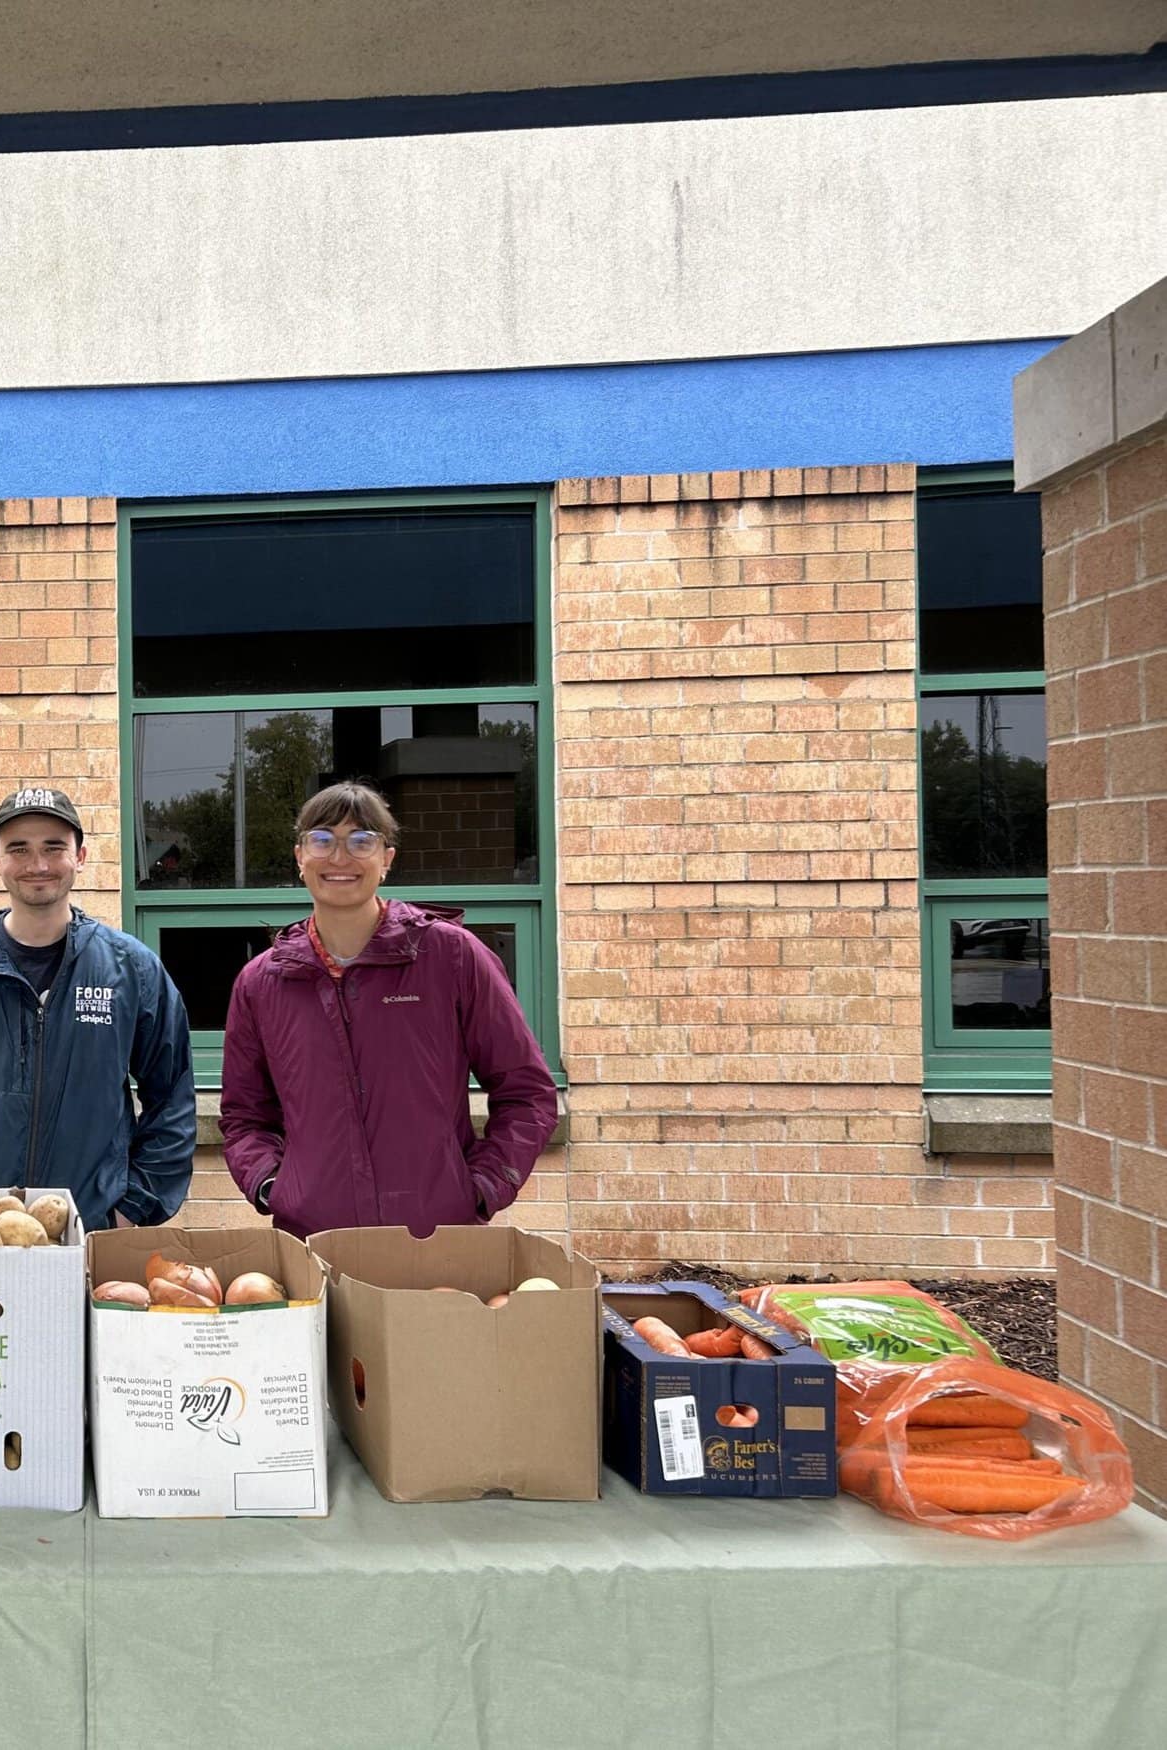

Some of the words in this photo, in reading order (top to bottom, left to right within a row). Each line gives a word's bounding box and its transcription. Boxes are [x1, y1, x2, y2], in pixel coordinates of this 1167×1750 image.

[76, 987, 113, 1000] FOOD
[389, 994, 420, 1003] Columbia
[76, 1005, 111, 1013] NETWORK
[80, 1014, 104, 1024] Shipt
[128, 1378, 161, 1387] Heirloom
[263, 1375, 297, 1383] Valencias
[803, 1377, 825, 1385] COUNT
[113, 1386, 139, 1396] Orange
[141, 1389, 162, 1398] Blood
[260, 1385, 298, 1395] Minneolas
[128, 1399, 162, 1408] Pummelo
[180, 1386, 231, 1422] Vivid
[260, 1396, 298, 1405] Mandarins
[126, 1409, 163, 1419] Grapefruit
[265, 1408, 281, 1416] Cara
[282, 1407, 299, 1415] Cara
[135, 1420, 164, 1429] Lemons
[275, 1418, 300, 1426] Navels
[156, 1488, 166, 1497] OF
[167, 1488, 200, 1497] PRODUCE
